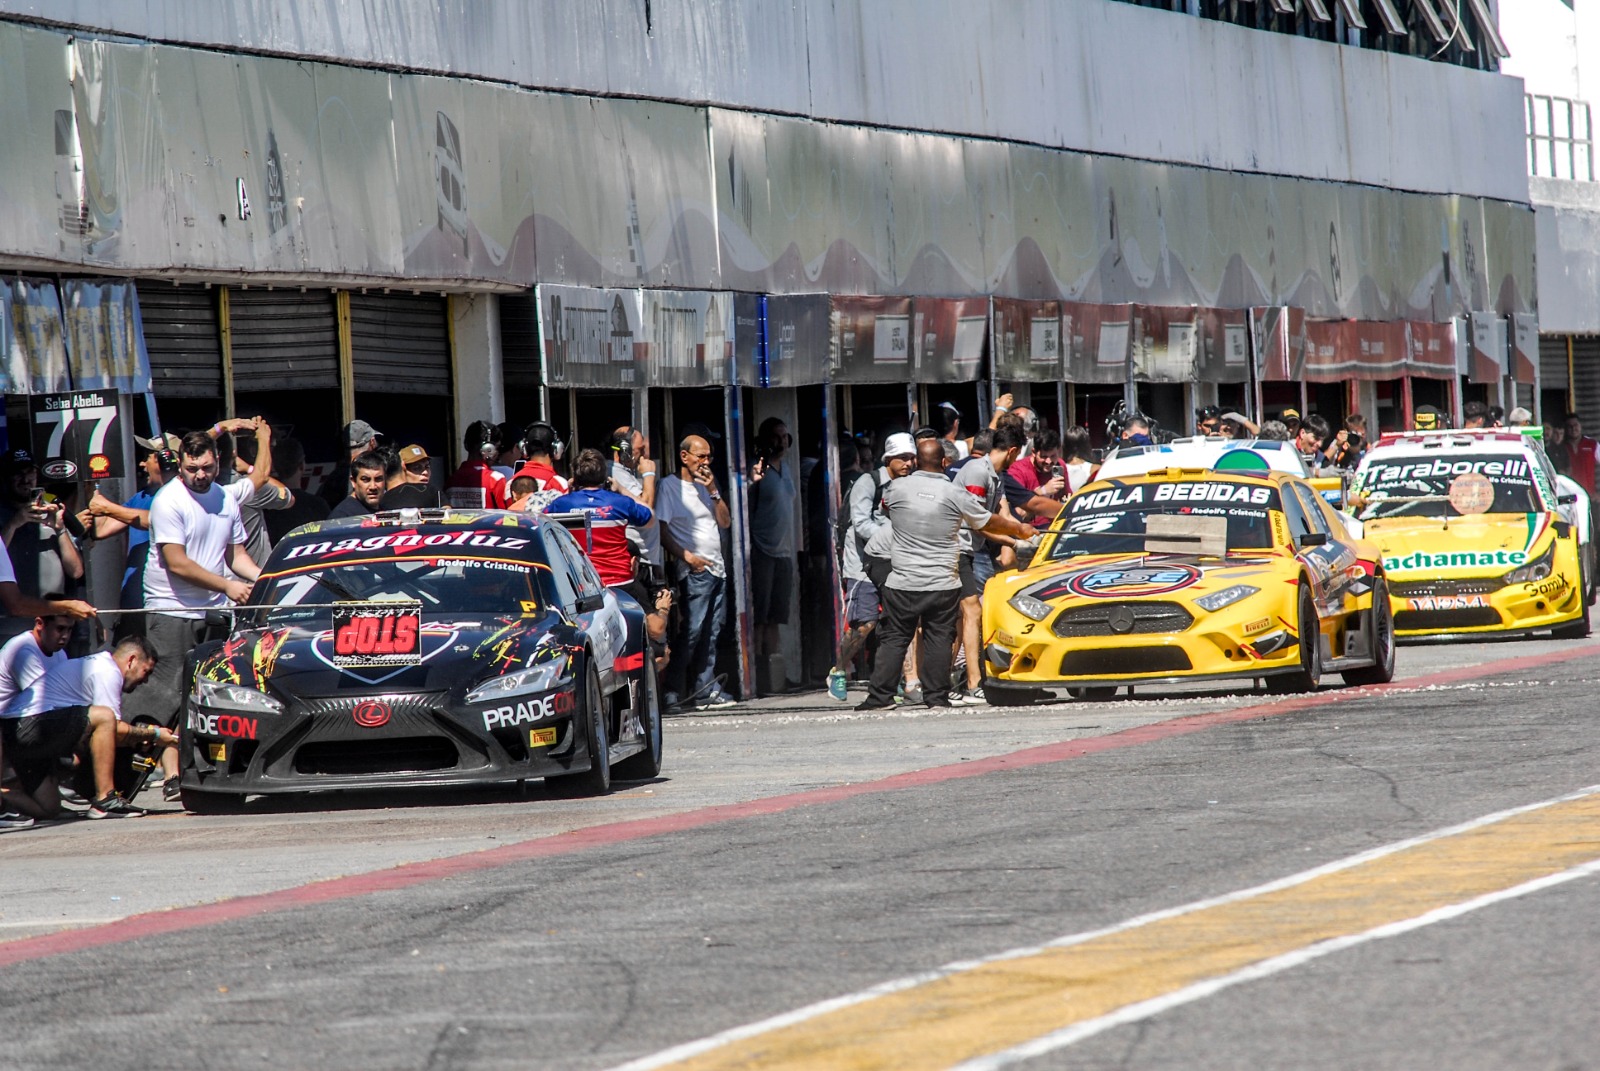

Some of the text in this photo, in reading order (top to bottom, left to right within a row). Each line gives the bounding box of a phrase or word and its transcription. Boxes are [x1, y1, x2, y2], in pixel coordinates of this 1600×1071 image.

[45, 394, 103, 409] Seba Abella
[35, 406, 117, 458] 77
[1368, 460, 1527, 482] Taraborelli
[1072, 484, 1271, 513] MOLA BEBIDAS
[283, 531, 530, 560] magnoluz
[437, 559, 530, 573] Rodolfo Cristales
[1384, 551, 1526, 570] achamate
[336, 615, 418, 654] STOP
[1021, 623, 1035, 635] 3
[1245, 617, 1270, 633] PIRELLI
